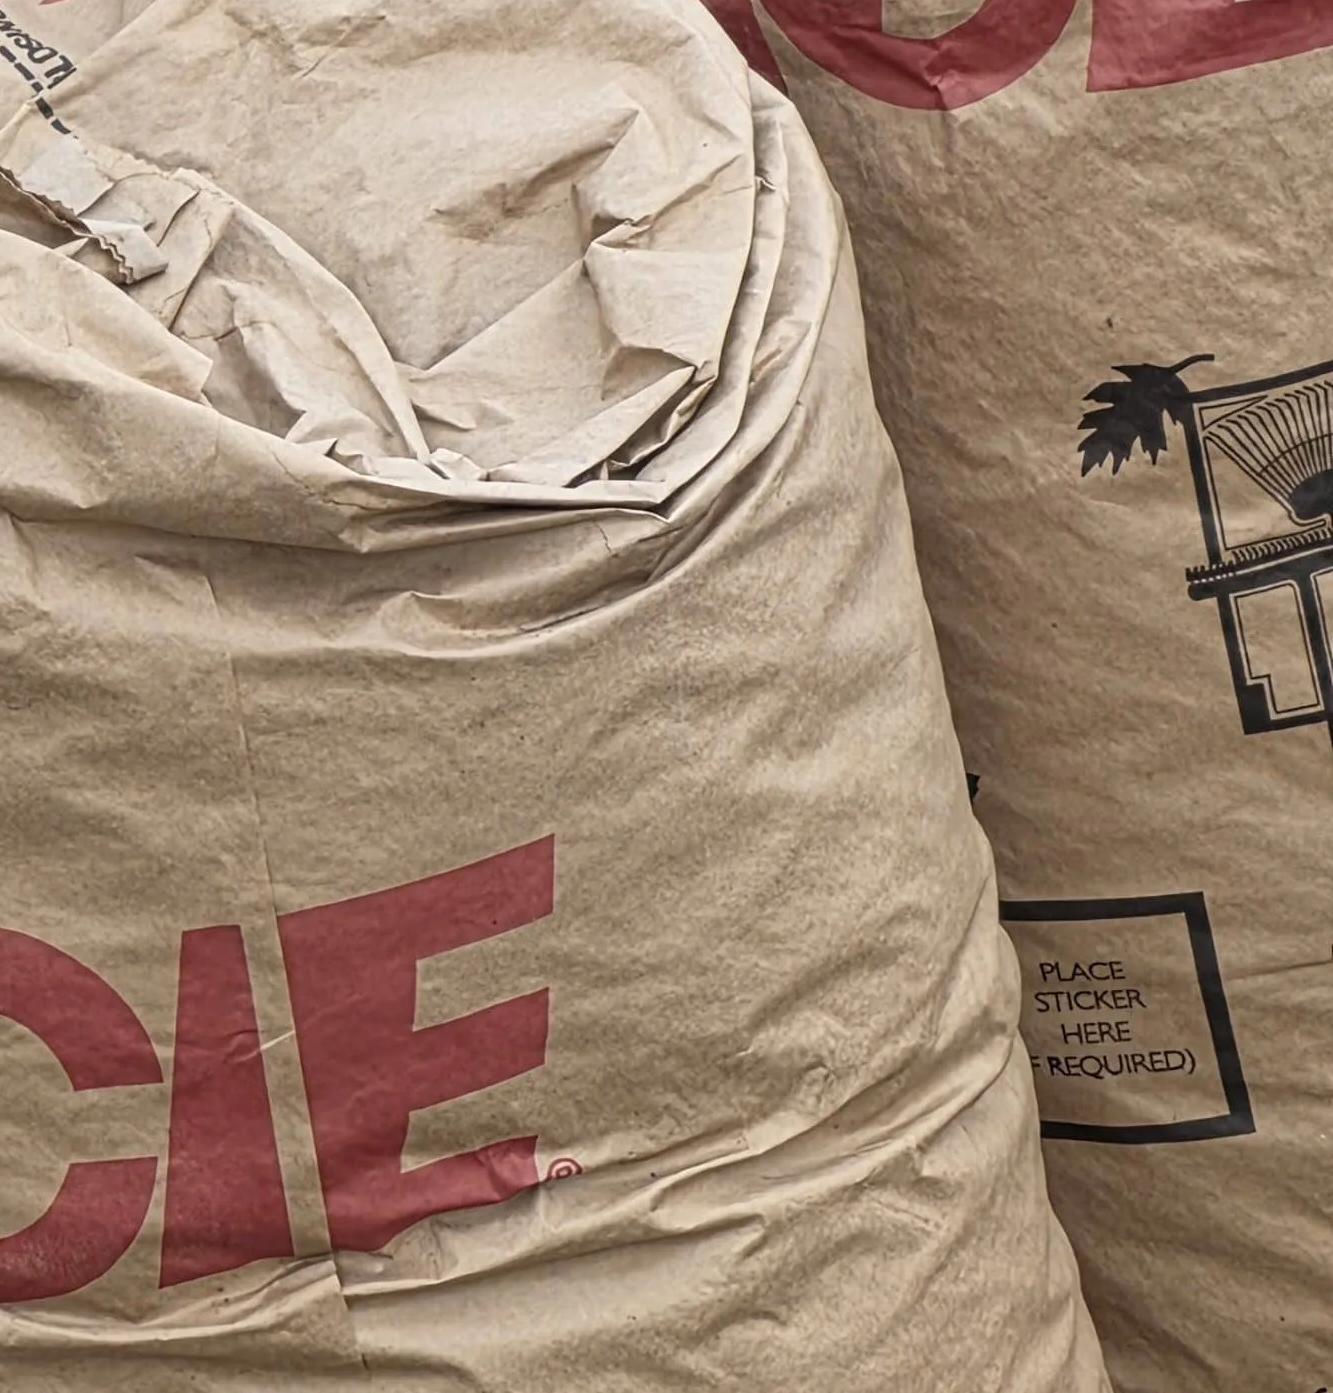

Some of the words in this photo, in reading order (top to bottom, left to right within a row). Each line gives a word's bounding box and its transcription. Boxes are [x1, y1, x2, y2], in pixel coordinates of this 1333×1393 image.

[1038, 960, 1127, 983] PLACE
[1034, 988, 1148, 1013] STICKER
[1060, 1020, 1133, 1046] HERE
[1046, 1048, 1197, 1081] REQUIRED)
